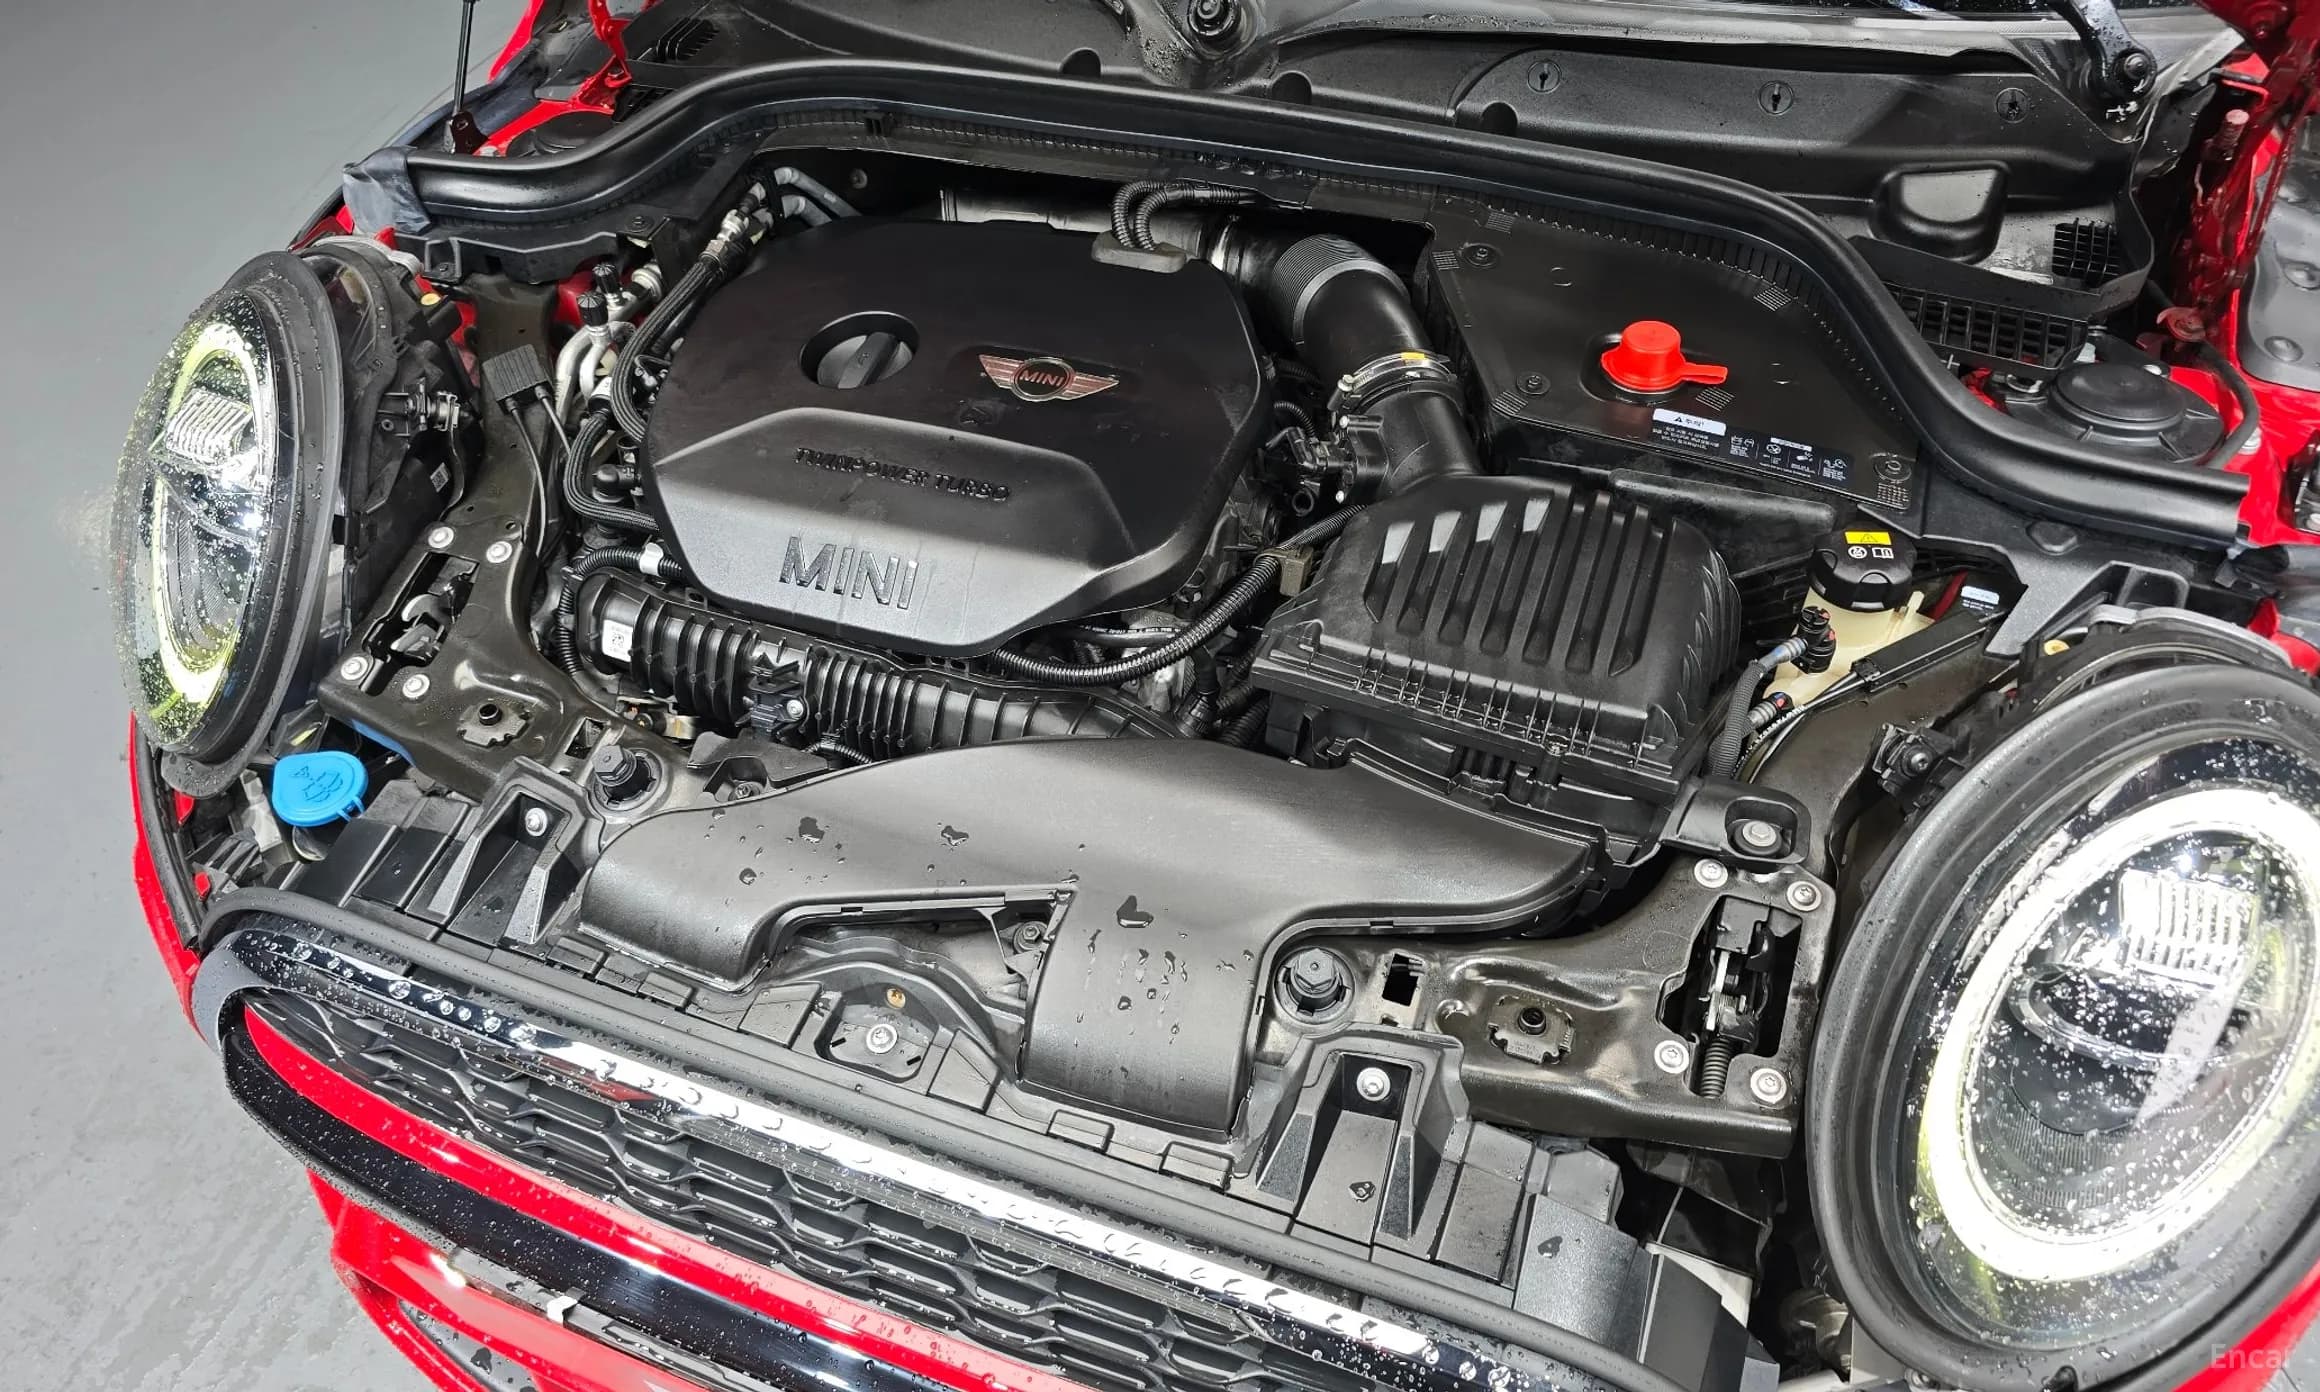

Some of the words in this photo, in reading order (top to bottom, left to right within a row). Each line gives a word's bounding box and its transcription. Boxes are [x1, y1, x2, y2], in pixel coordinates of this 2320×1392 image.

[1019, 370, 1065, 387] MINI
[794, 447, 930, 487] TWINPOWER
[935, 473, 1011, 502] TURBO
[778, 536, 920, 610] MINI
